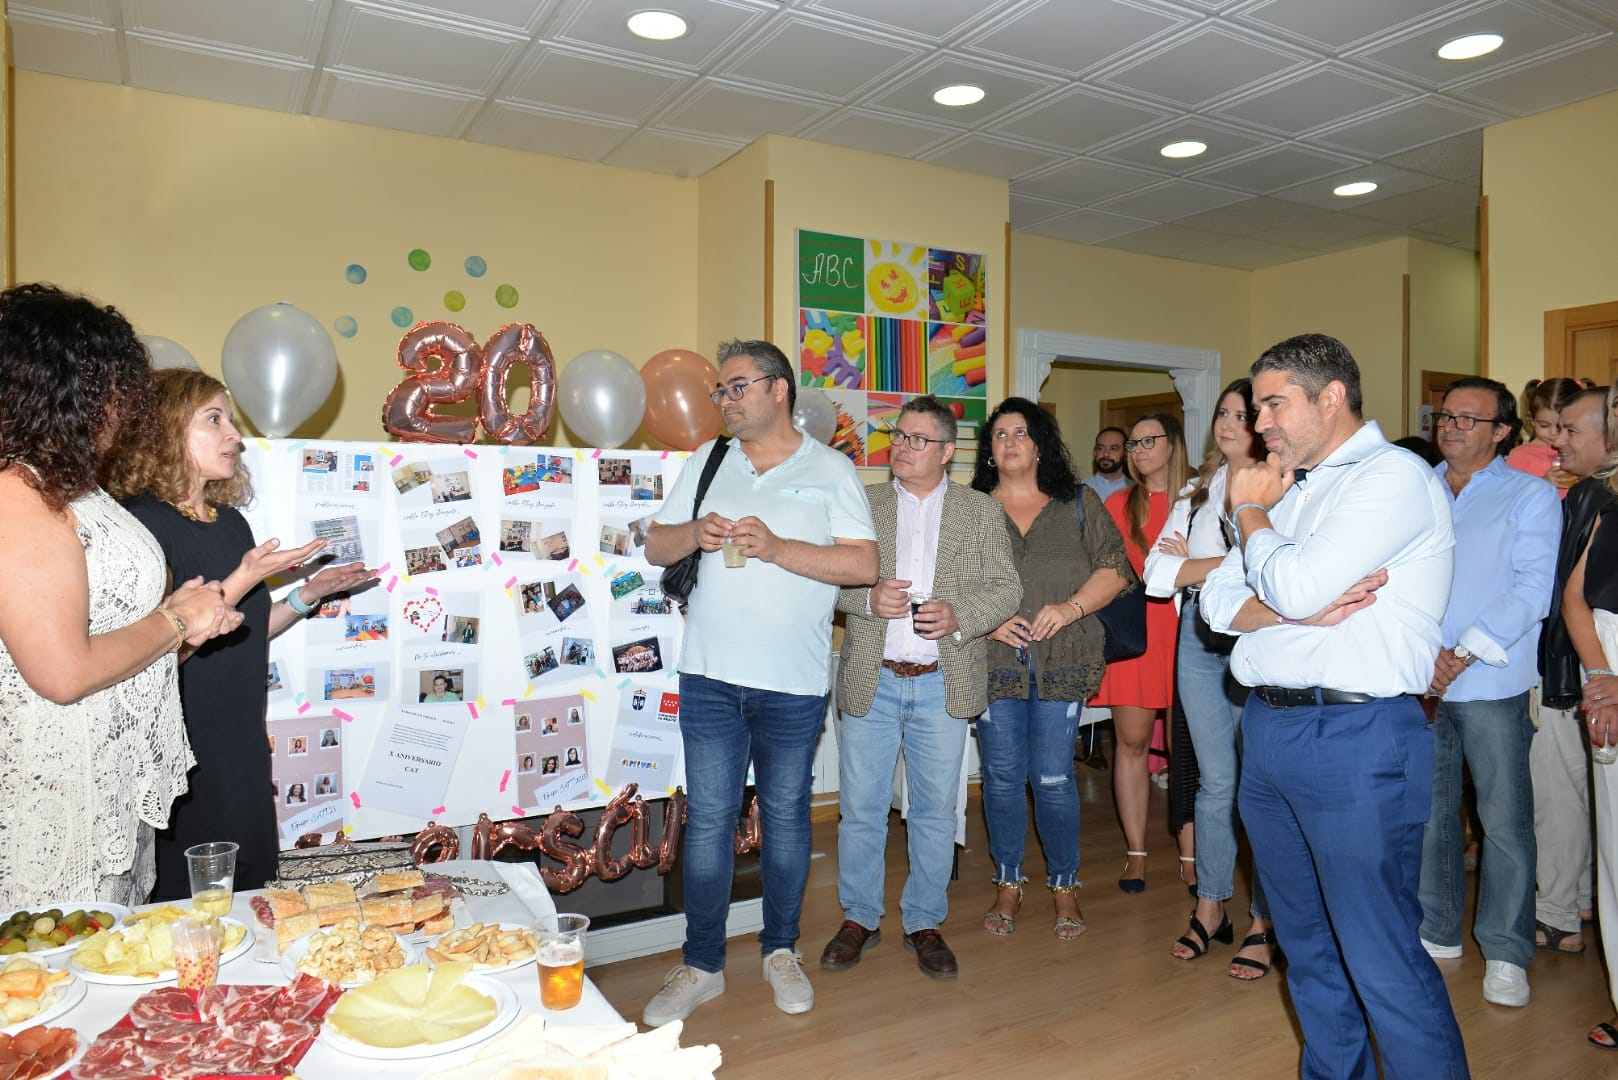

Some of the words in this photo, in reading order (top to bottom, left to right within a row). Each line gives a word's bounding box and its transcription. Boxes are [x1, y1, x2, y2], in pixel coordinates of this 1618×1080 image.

[801, 252, 859, 289] ABC
[382, 320, 558, 445] 20
[395, 752, 442, 768] ANIVERSARIO
[404, 765, 420, 774] CAT
